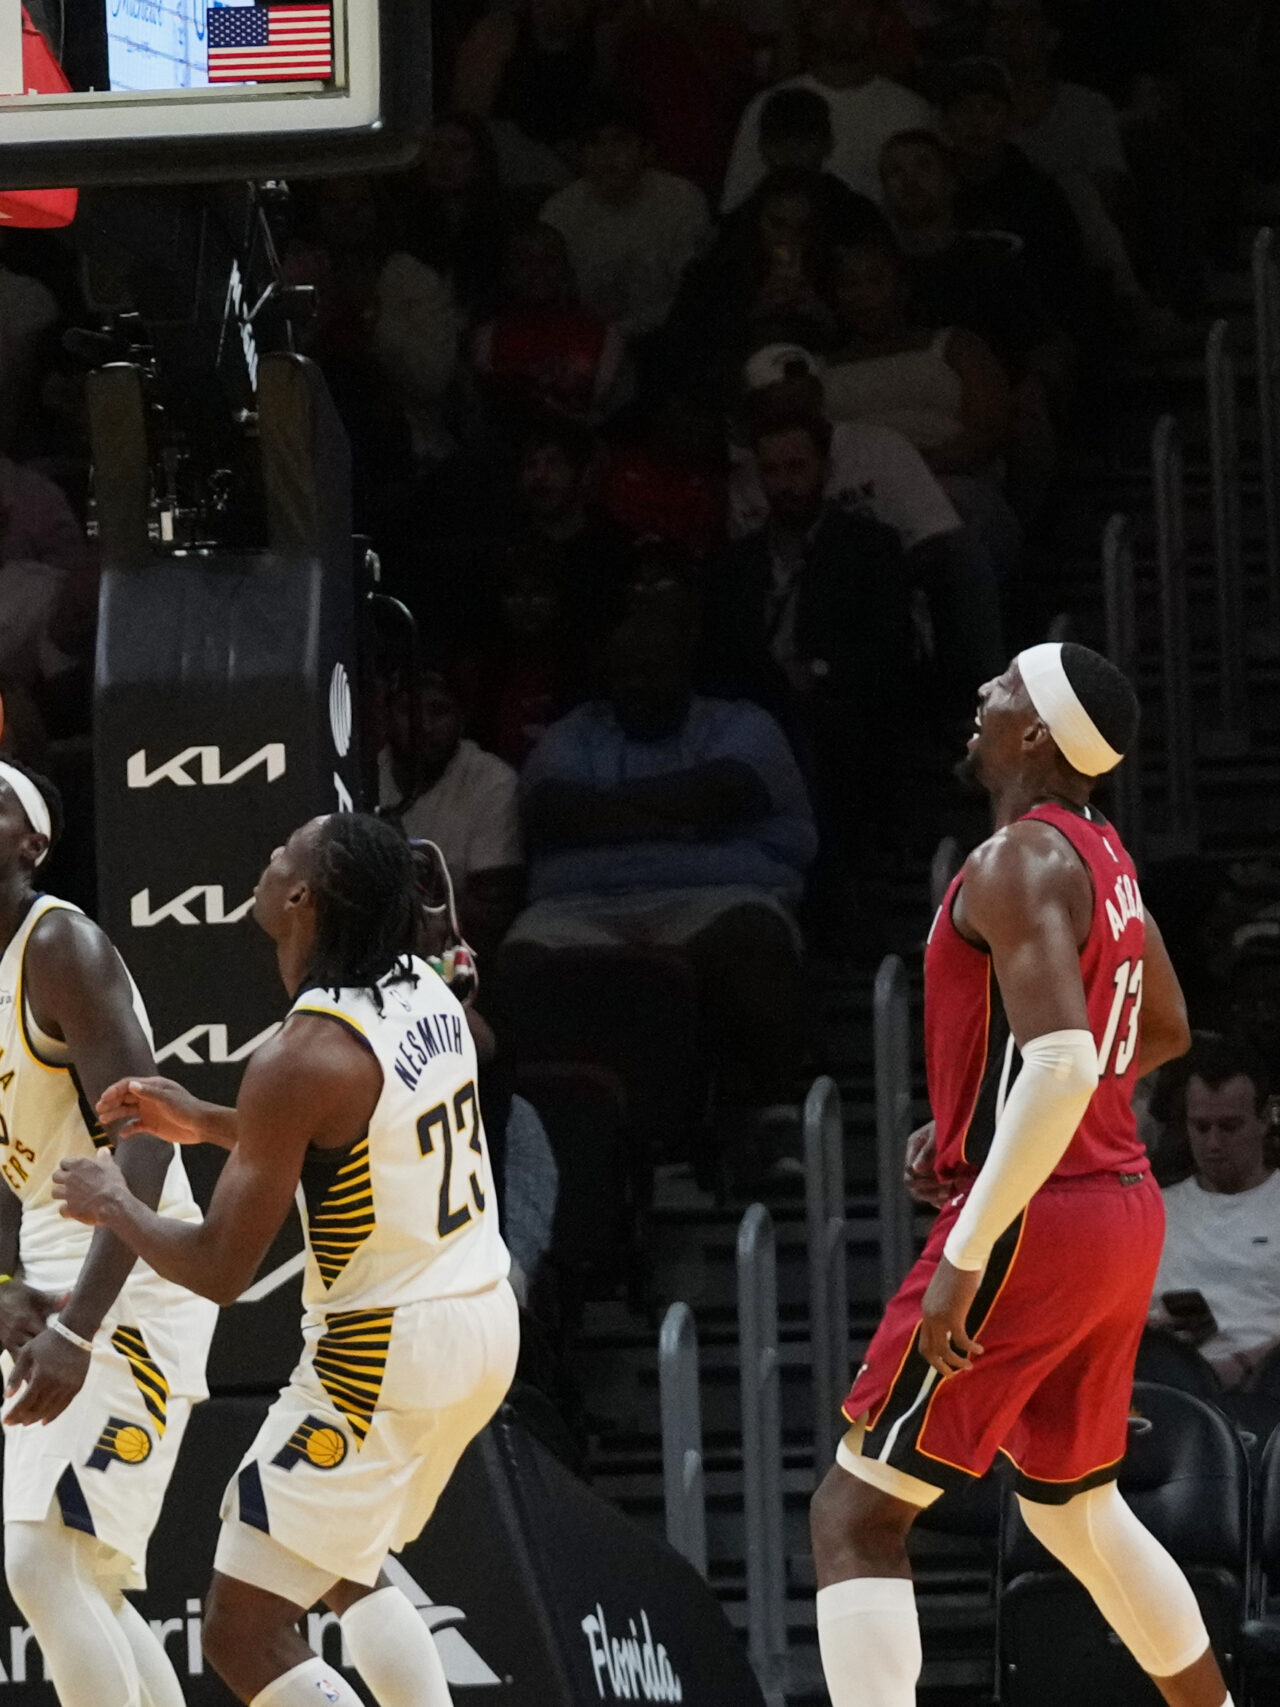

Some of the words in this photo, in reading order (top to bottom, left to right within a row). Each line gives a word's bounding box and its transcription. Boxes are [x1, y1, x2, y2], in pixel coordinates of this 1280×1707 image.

[127, 743, 286, 788] KIA
[394, 1013, 463, 1092] NESMITH
[1098, 958, 1143, 1076] 13
[416, 1081, 485, 1238] 23
[581, 1602, 683, 1703] Florida
